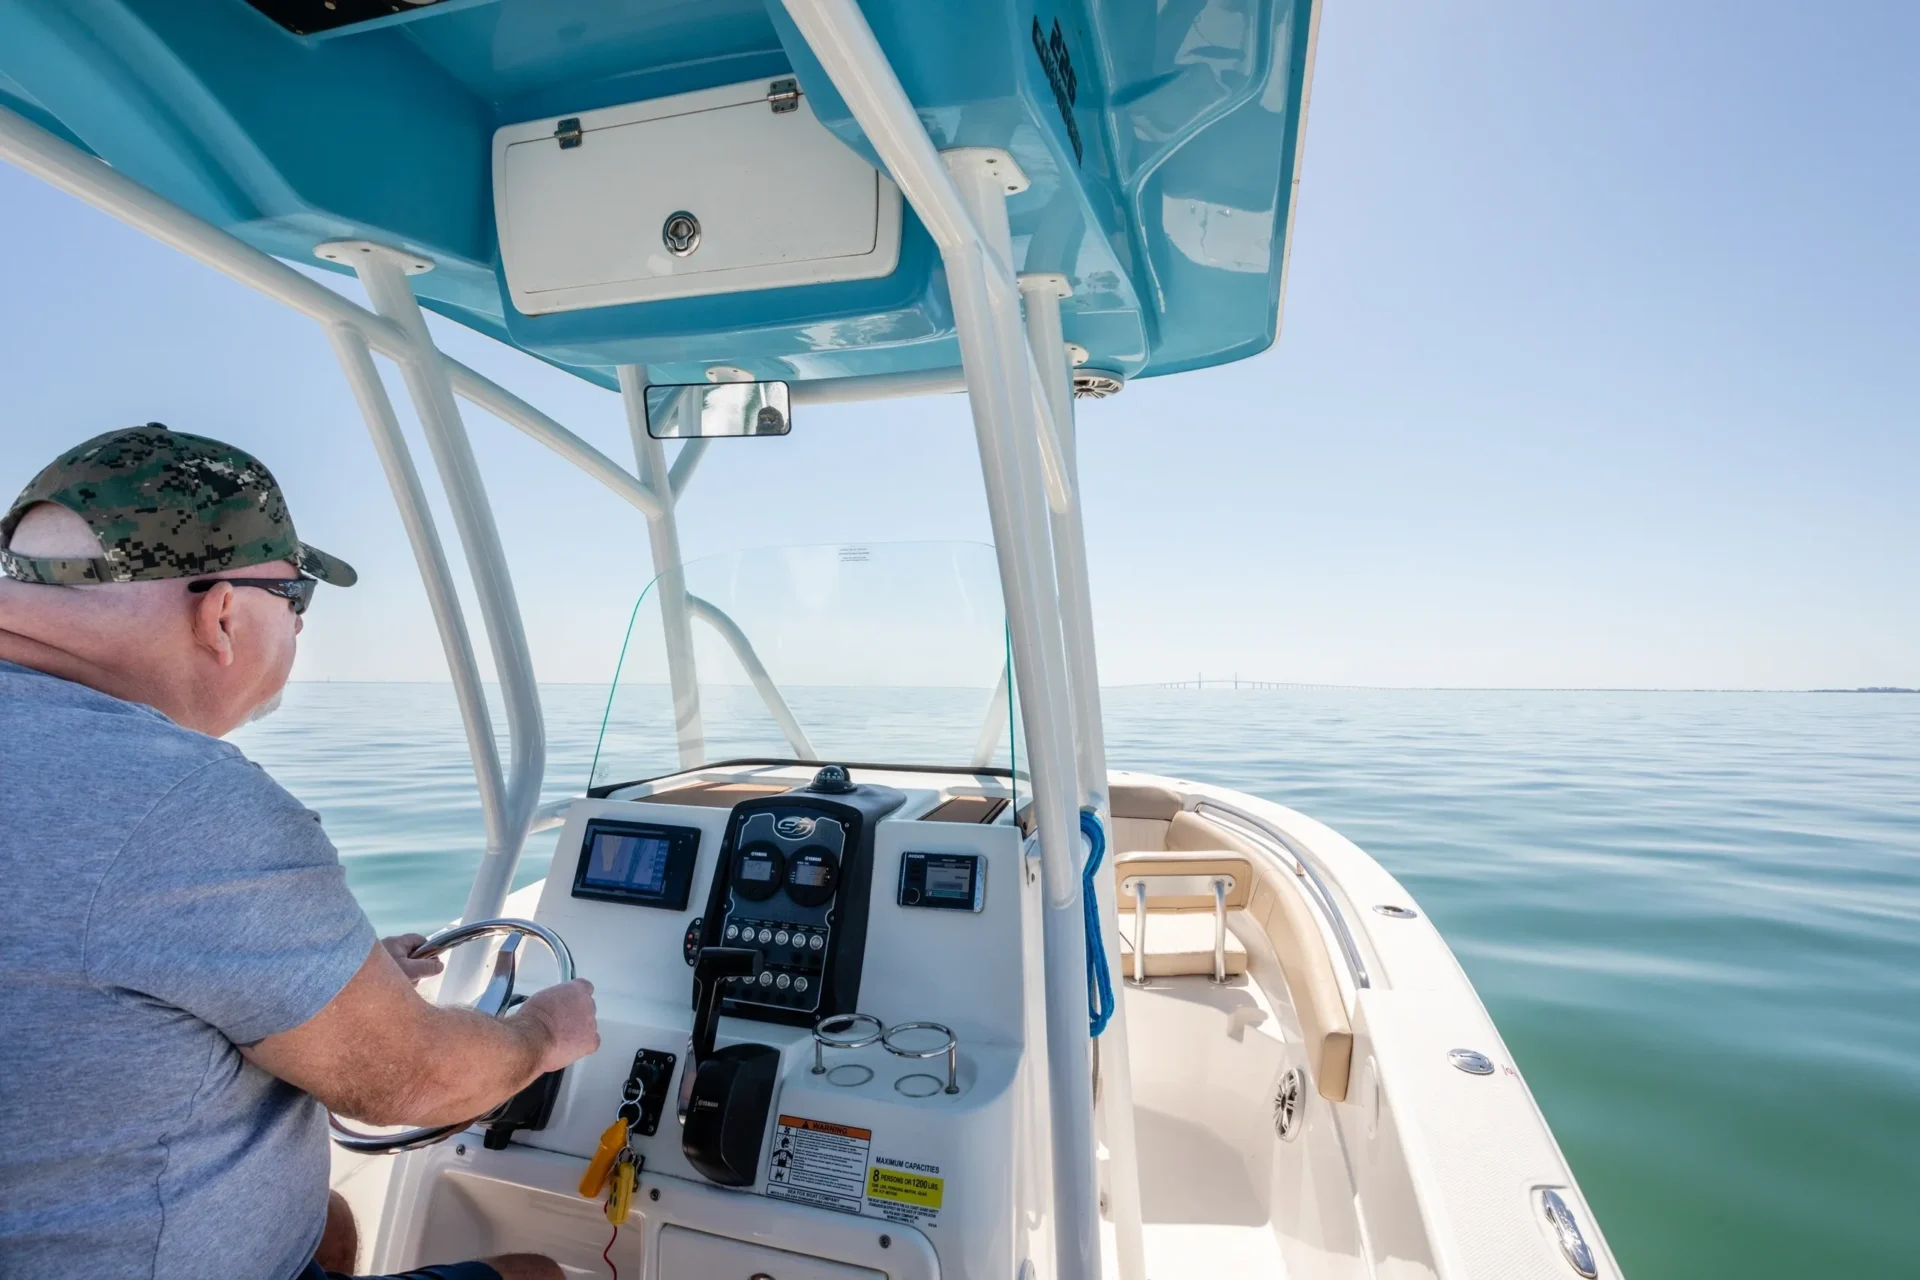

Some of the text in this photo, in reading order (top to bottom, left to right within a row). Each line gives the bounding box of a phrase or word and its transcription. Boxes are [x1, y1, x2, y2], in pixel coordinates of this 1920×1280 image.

[812, 1122, 848, 1135] WARNING
[876, 1157, 940, 1173] MAXIMUM CAPACITIES
[873, 1169, 880, 1182] 8
[880, 1175, 903, 1184] PERSONS
[912, 1179, 927, 1188] 1200
